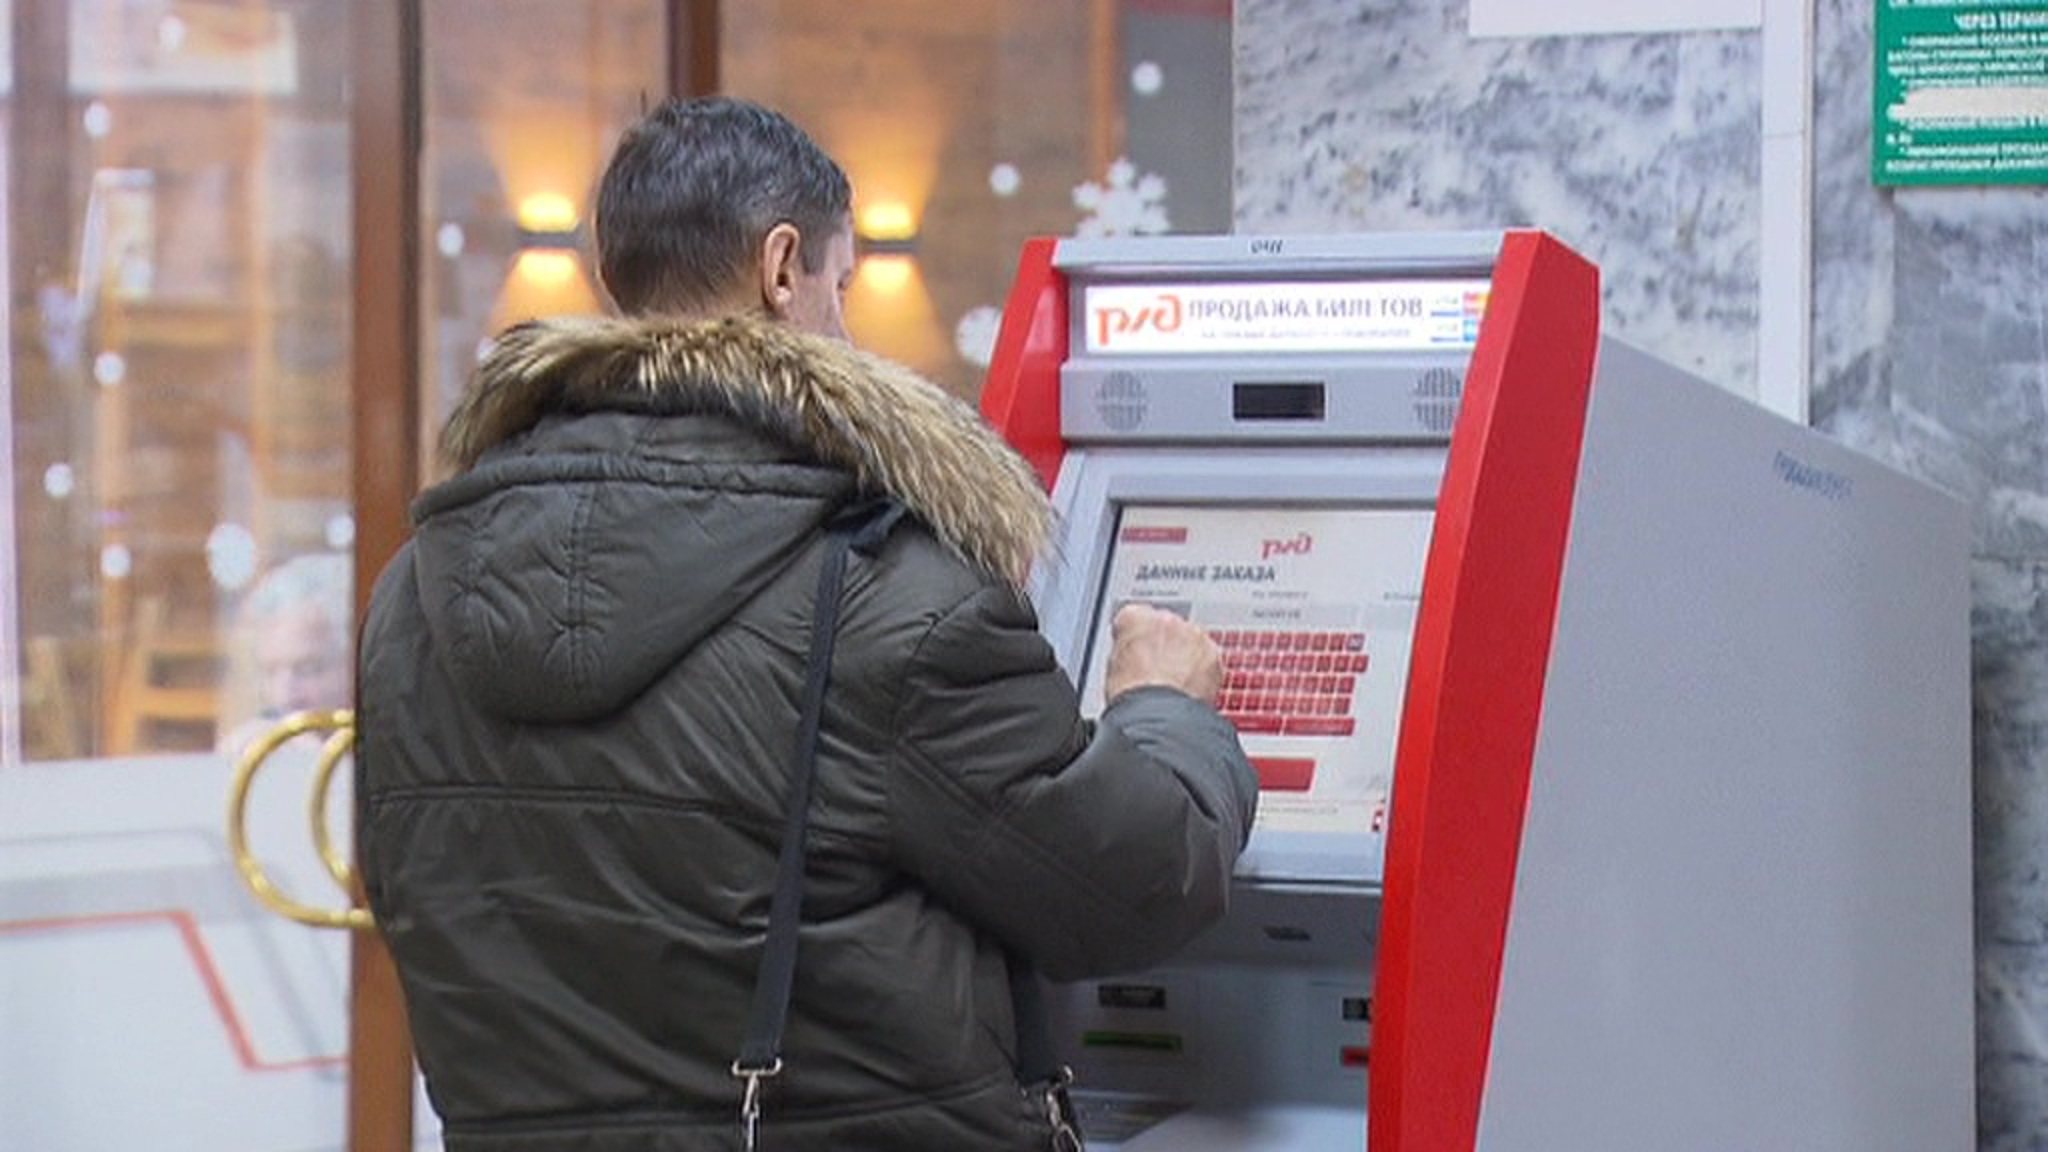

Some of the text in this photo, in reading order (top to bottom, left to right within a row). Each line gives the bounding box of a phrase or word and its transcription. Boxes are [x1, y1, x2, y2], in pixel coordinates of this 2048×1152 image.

[1188, 298, 1311, 323] ПРОДАЖА
[1135, 564, 1276, 583] ДАННЫЕ ЗАКАЗА
